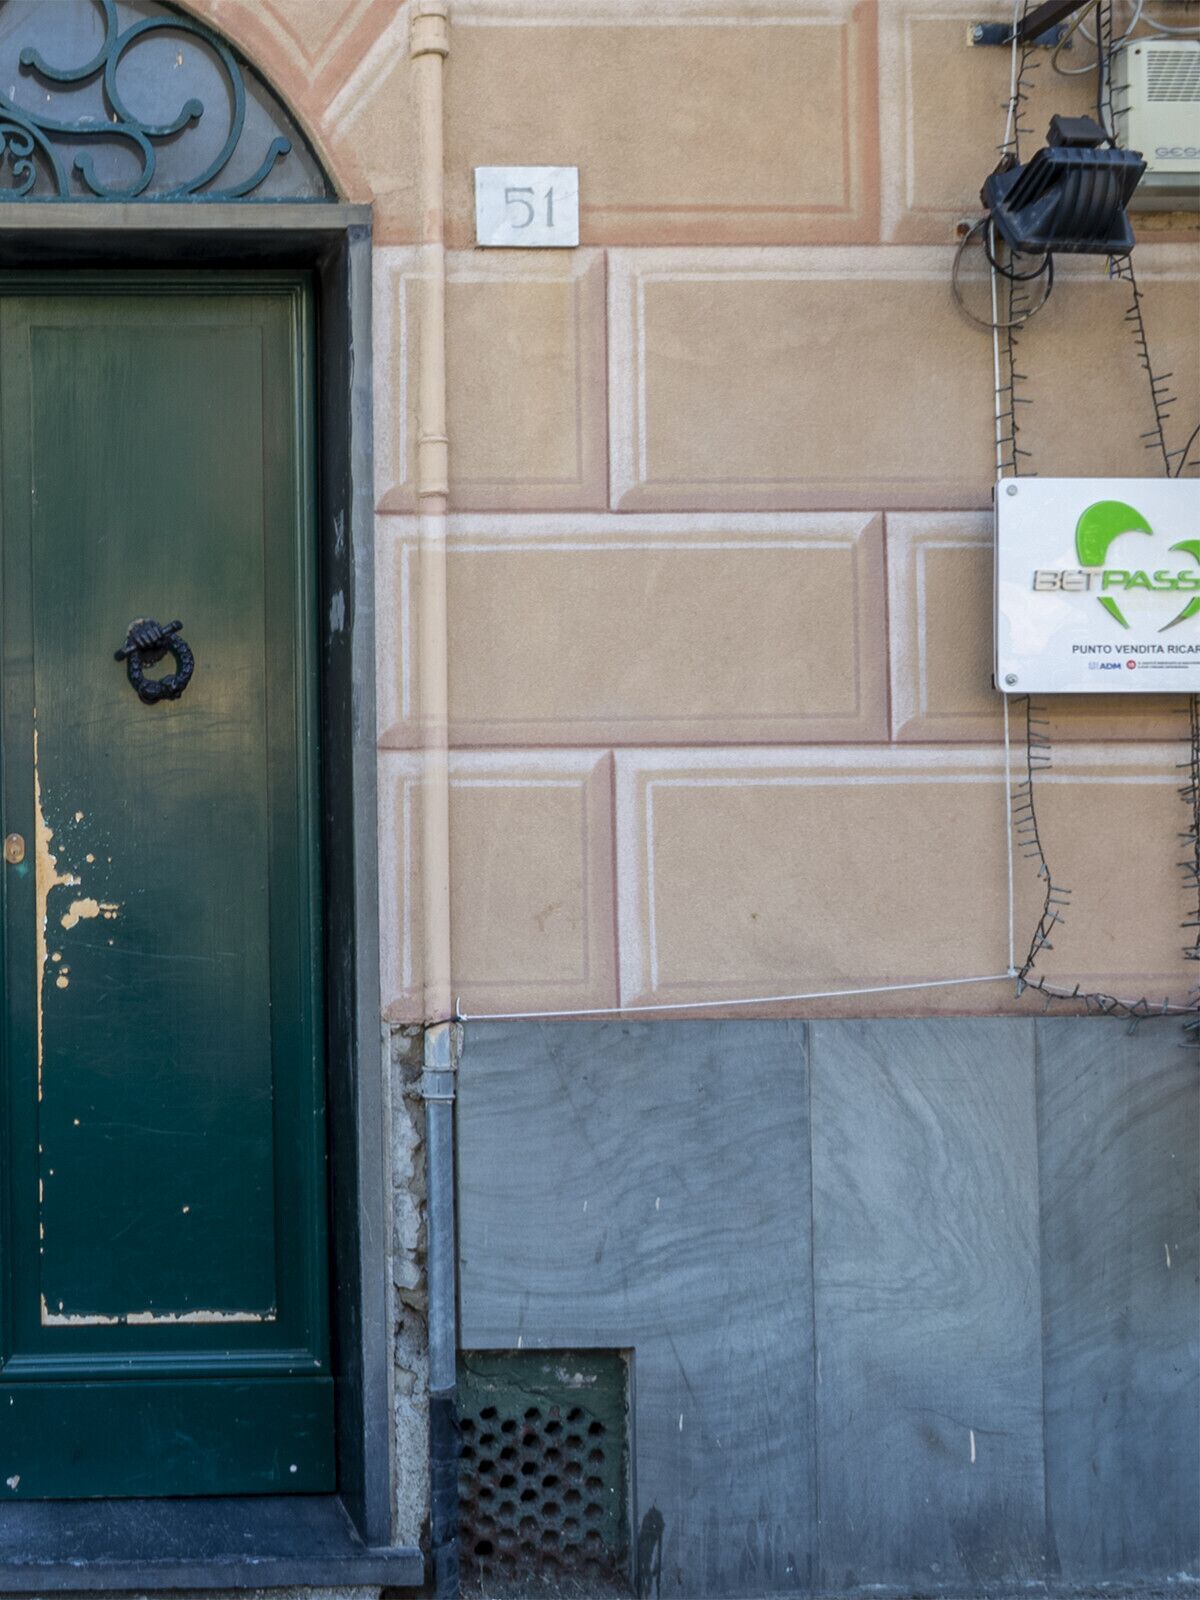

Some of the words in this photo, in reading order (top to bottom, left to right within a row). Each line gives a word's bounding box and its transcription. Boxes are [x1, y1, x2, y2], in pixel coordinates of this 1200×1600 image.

[504, 186, 555, 229] 51
[1033, 570, 1200, 591] BETPASS
[1072, 645, 1112, 655] PUNTO
[1115, 645, 1164, 655] VENDITA
